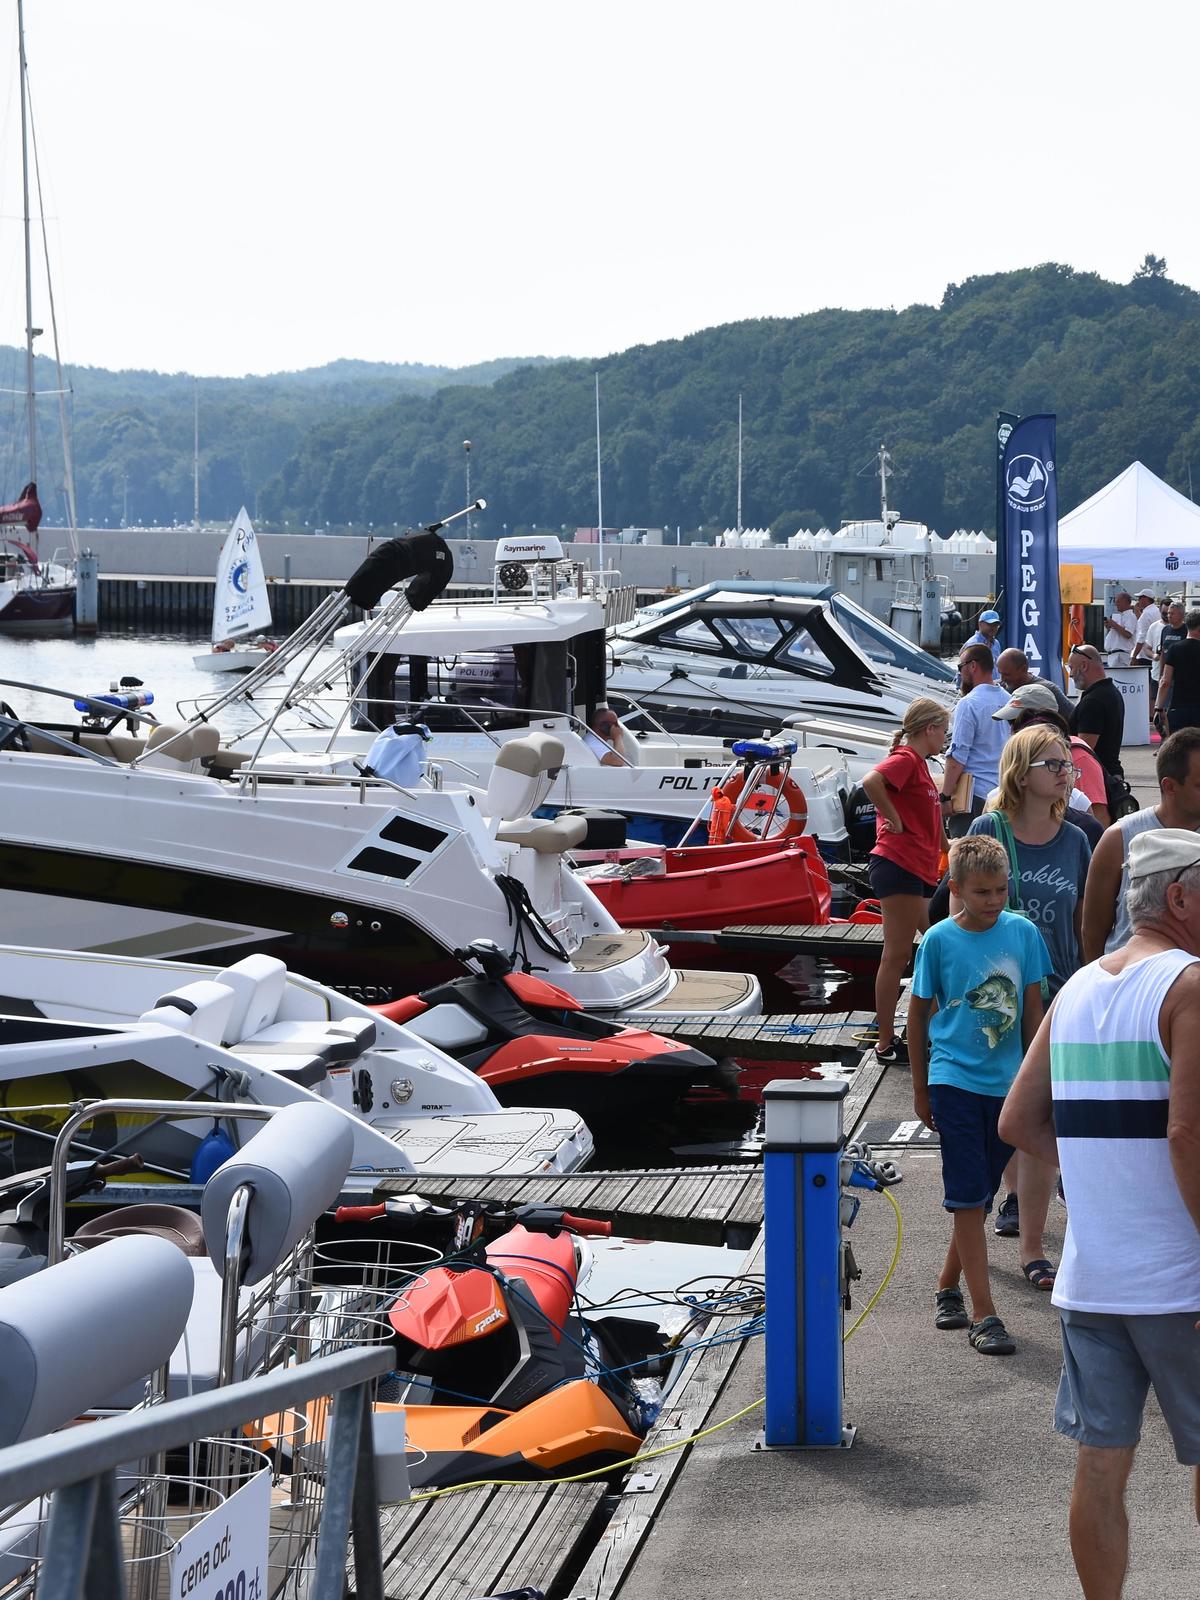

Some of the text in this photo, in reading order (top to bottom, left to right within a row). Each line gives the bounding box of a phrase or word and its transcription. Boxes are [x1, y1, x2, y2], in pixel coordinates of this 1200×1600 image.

[503, 543, 547, 553] Raymarine
[658, 776, 698, 791] POL
[474, 1309, 505, 1333] spark
[180, 1550, 210, 1599] cena
[213, 1524, 232, 1570] od:
